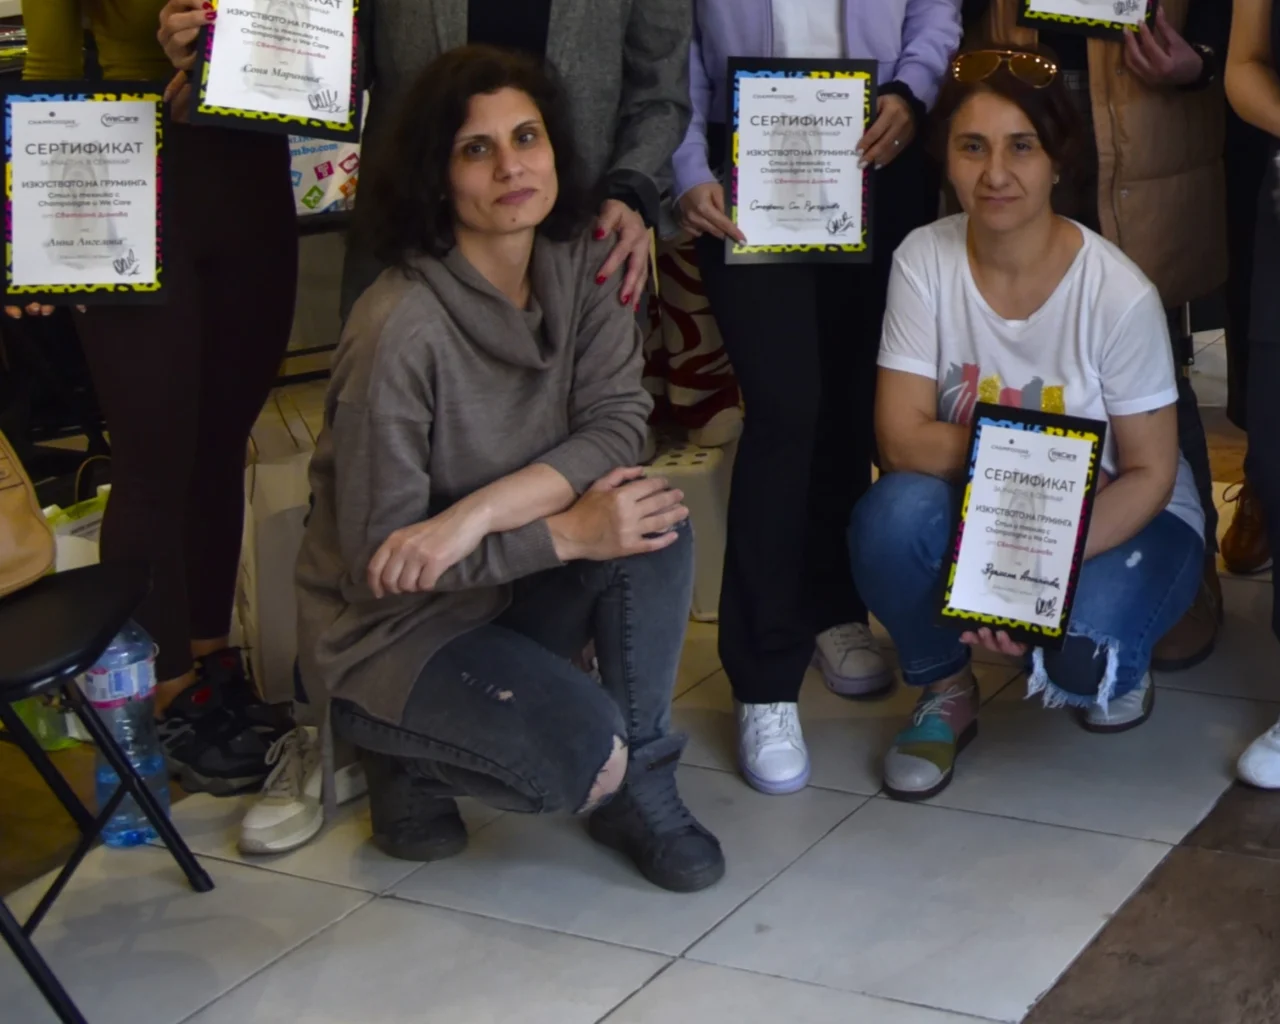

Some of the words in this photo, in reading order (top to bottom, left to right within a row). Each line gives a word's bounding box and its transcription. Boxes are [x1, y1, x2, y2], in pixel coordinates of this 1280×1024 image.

[226, 6, 286, 24] ИЗКУСТВОТО
[286, 19, 300, 27] НА
[300, 22, 344, 36] ГРУМИНГА
[749, 114, 852, 127] СЕРТИФИКАТ
[24, 141, 143, 155] СЕРТИФИКАТ
[21, 180, 84, 188] ИЗКУСТВОТО
[84, 179, 98, 187] НА
[99, 179, 147, 187] ГРУМИНГА
[983, 466, 1076, 493] СЕРТИФИКАТ
